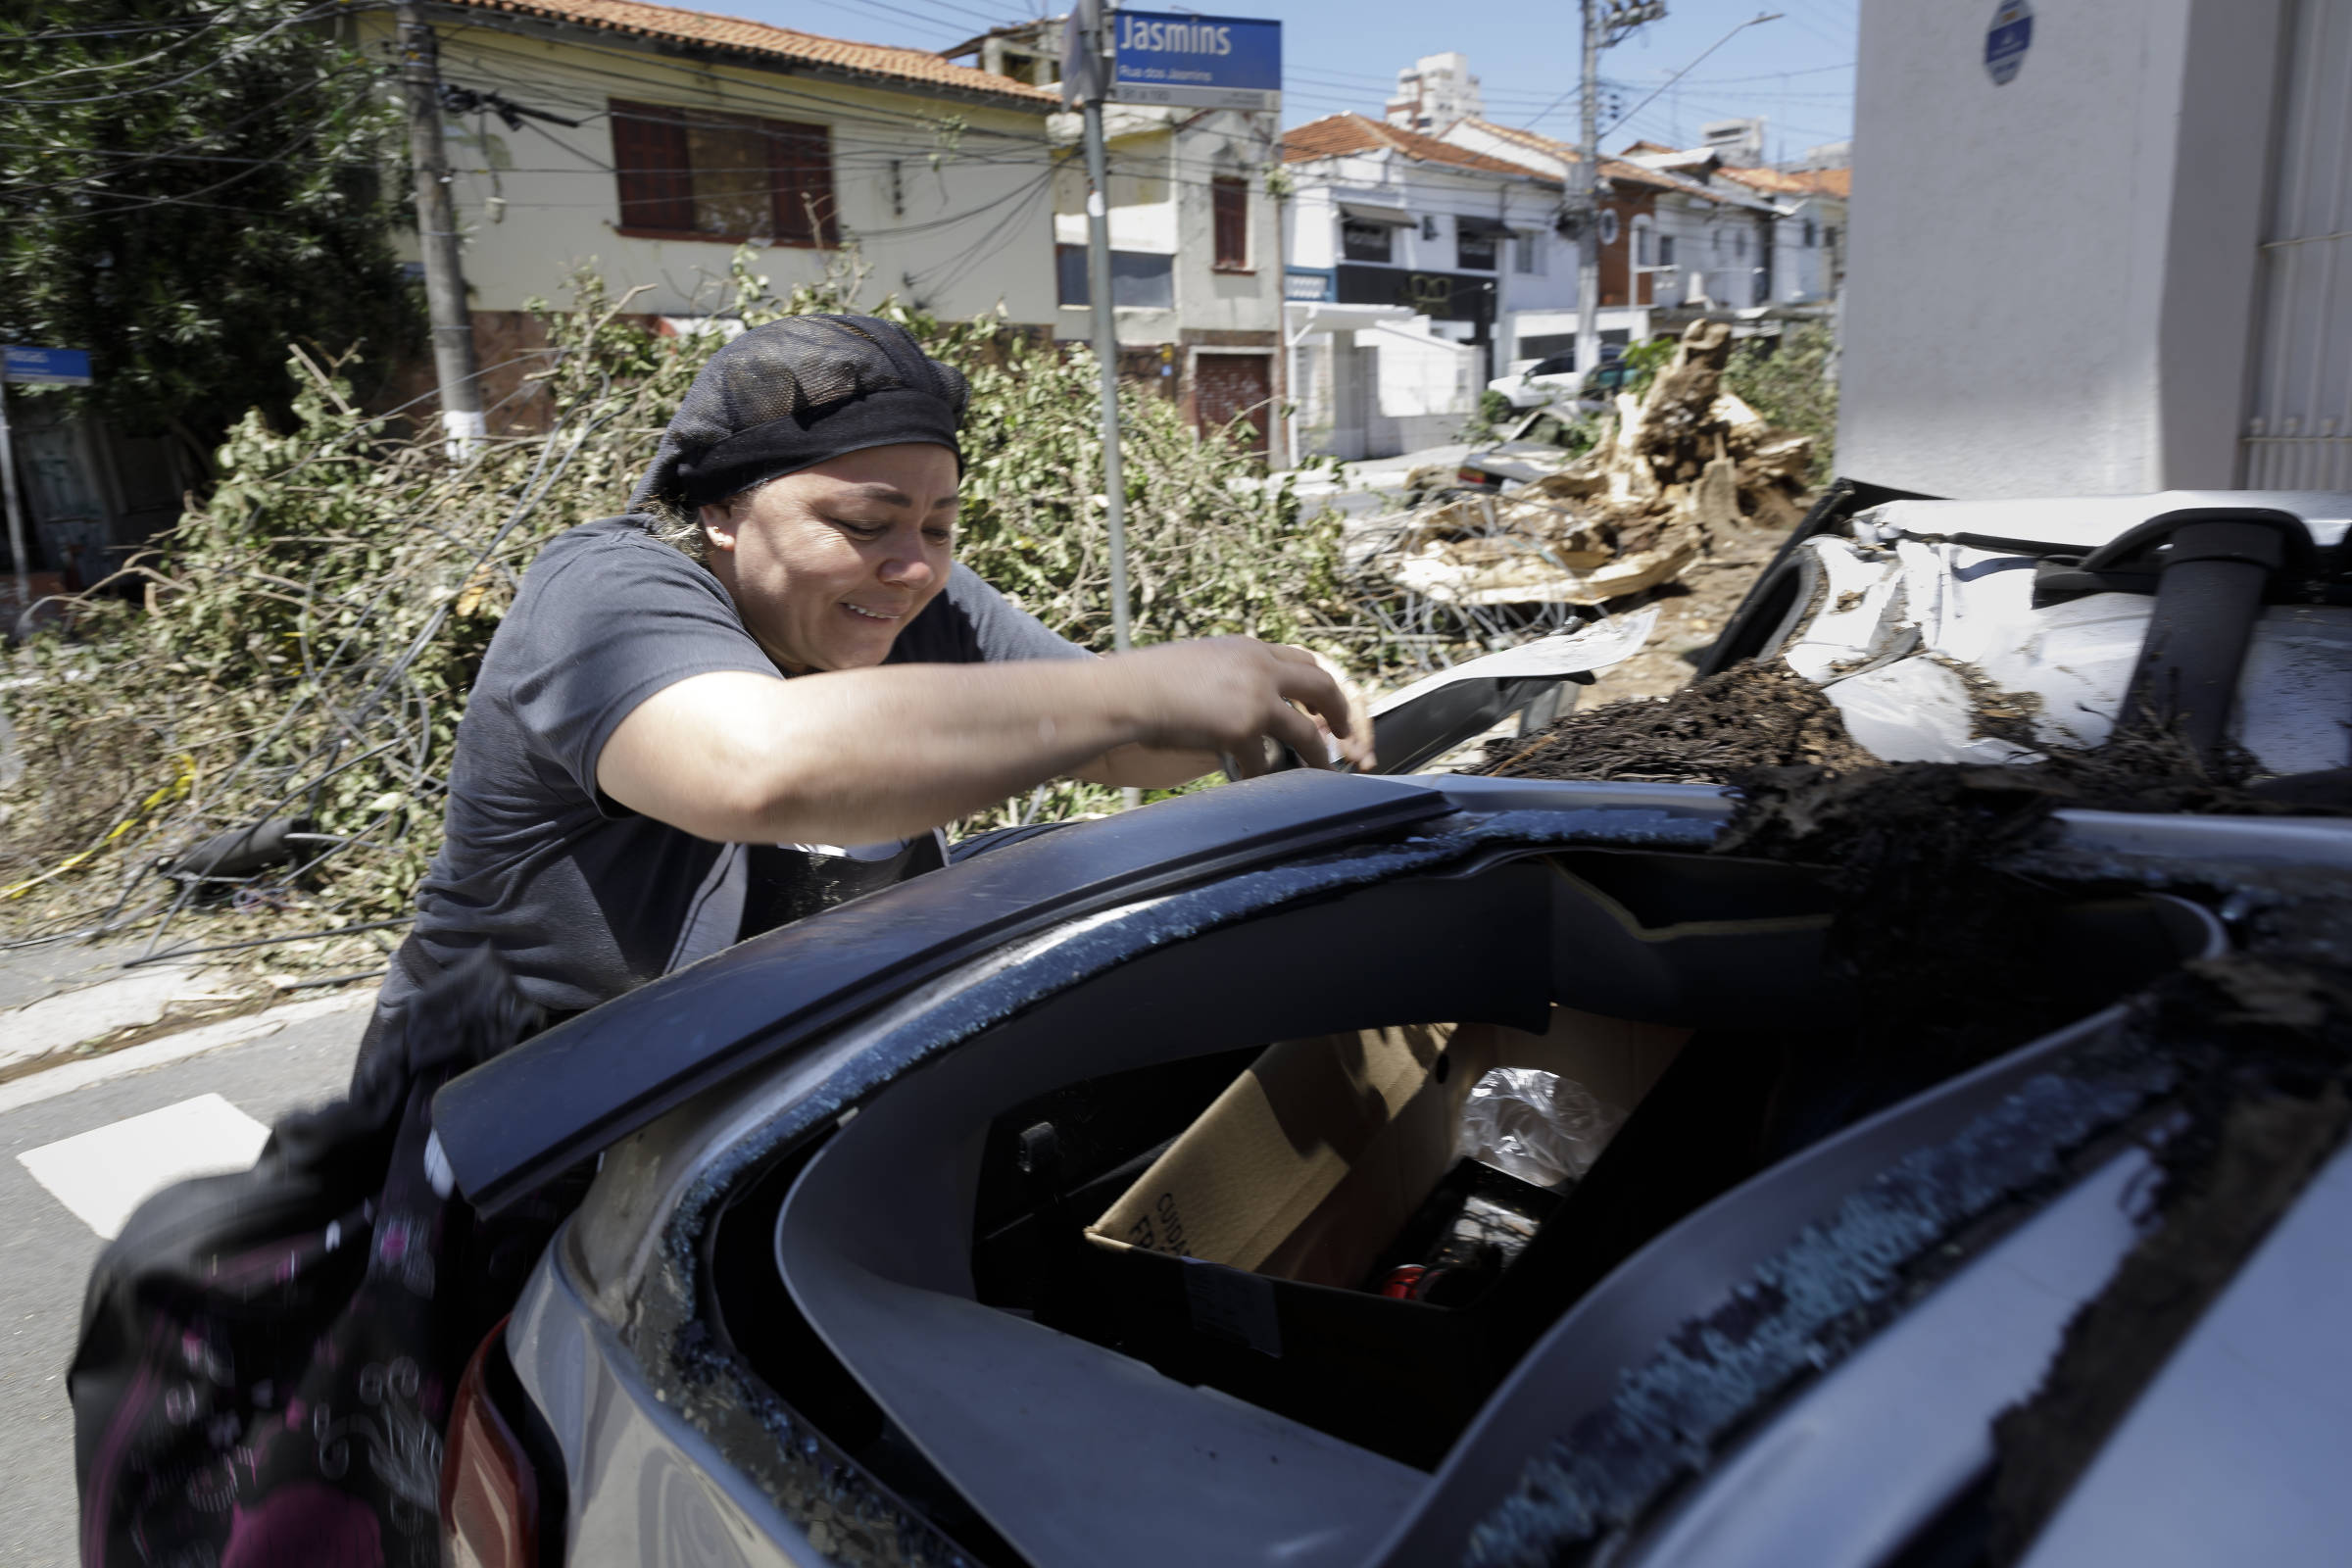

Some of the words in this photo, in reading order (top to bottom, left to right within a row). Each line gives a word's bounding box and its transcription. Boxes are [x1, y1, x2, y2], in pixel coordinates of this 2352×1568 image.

[1120, 16, 1232, 56] Jasmins
[1119, 65, 1142, 78] Rua
[1144, 68, 1165, 79] dos
[1156, 1193, 1192, 1256] CUIDA
